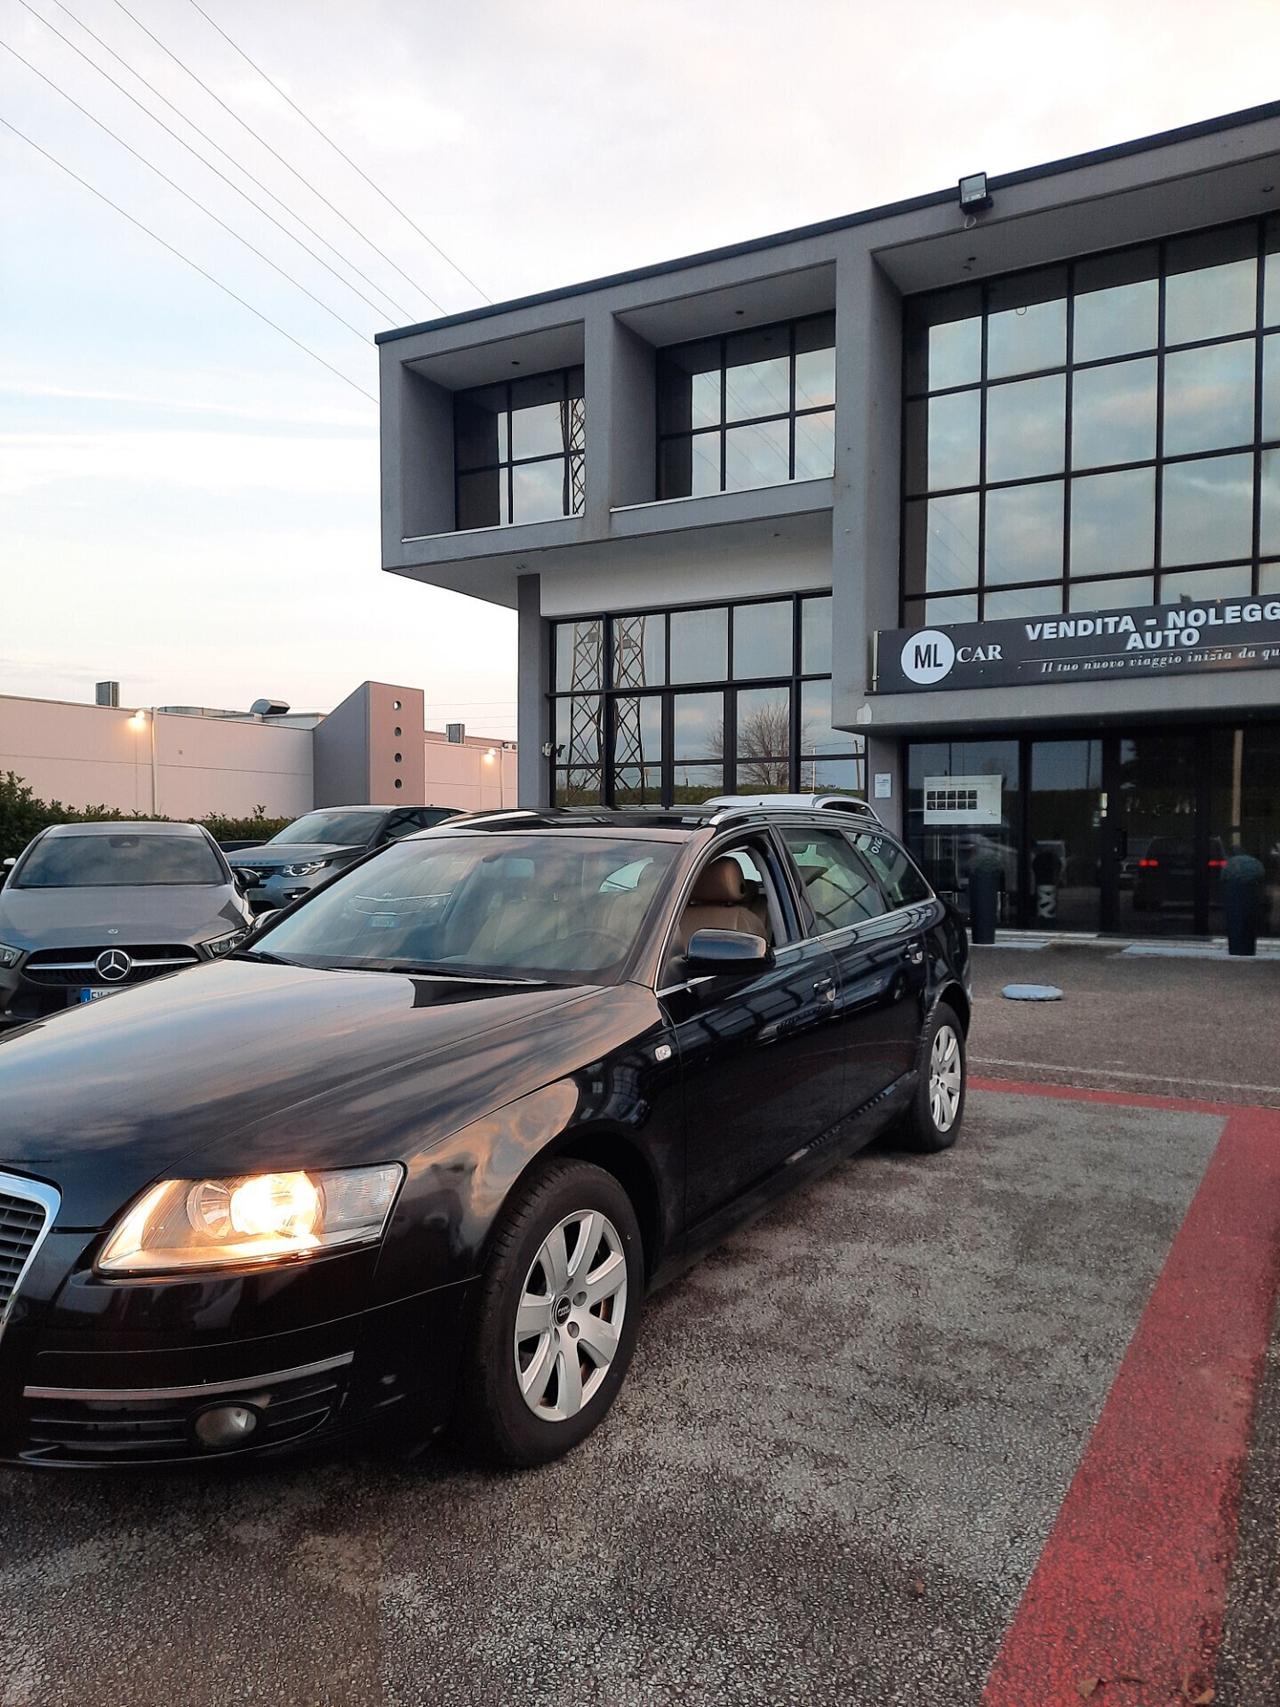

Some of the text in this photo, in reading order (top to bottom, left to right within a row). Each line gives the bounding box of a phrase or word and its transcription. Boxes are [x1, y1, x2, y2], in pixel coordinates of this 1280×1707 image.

[1025, 615, 1136, 641] VENDITA
[1167, 602, 1280, 629] NOLEGG
[1126, 627, 1200, 651] AUTO
[914, 644, 1003, 669] ML CAR
[1040, 662, 1054, 673] Il
[1057, 662, 1079, 671] tuo
[1083, 659, 1125, 670] nuovo
[1130, 653, 1182, 669] viaggio
[1187, 650, 1232, 662] inizia
[1238, 647, 1256, 659] da
